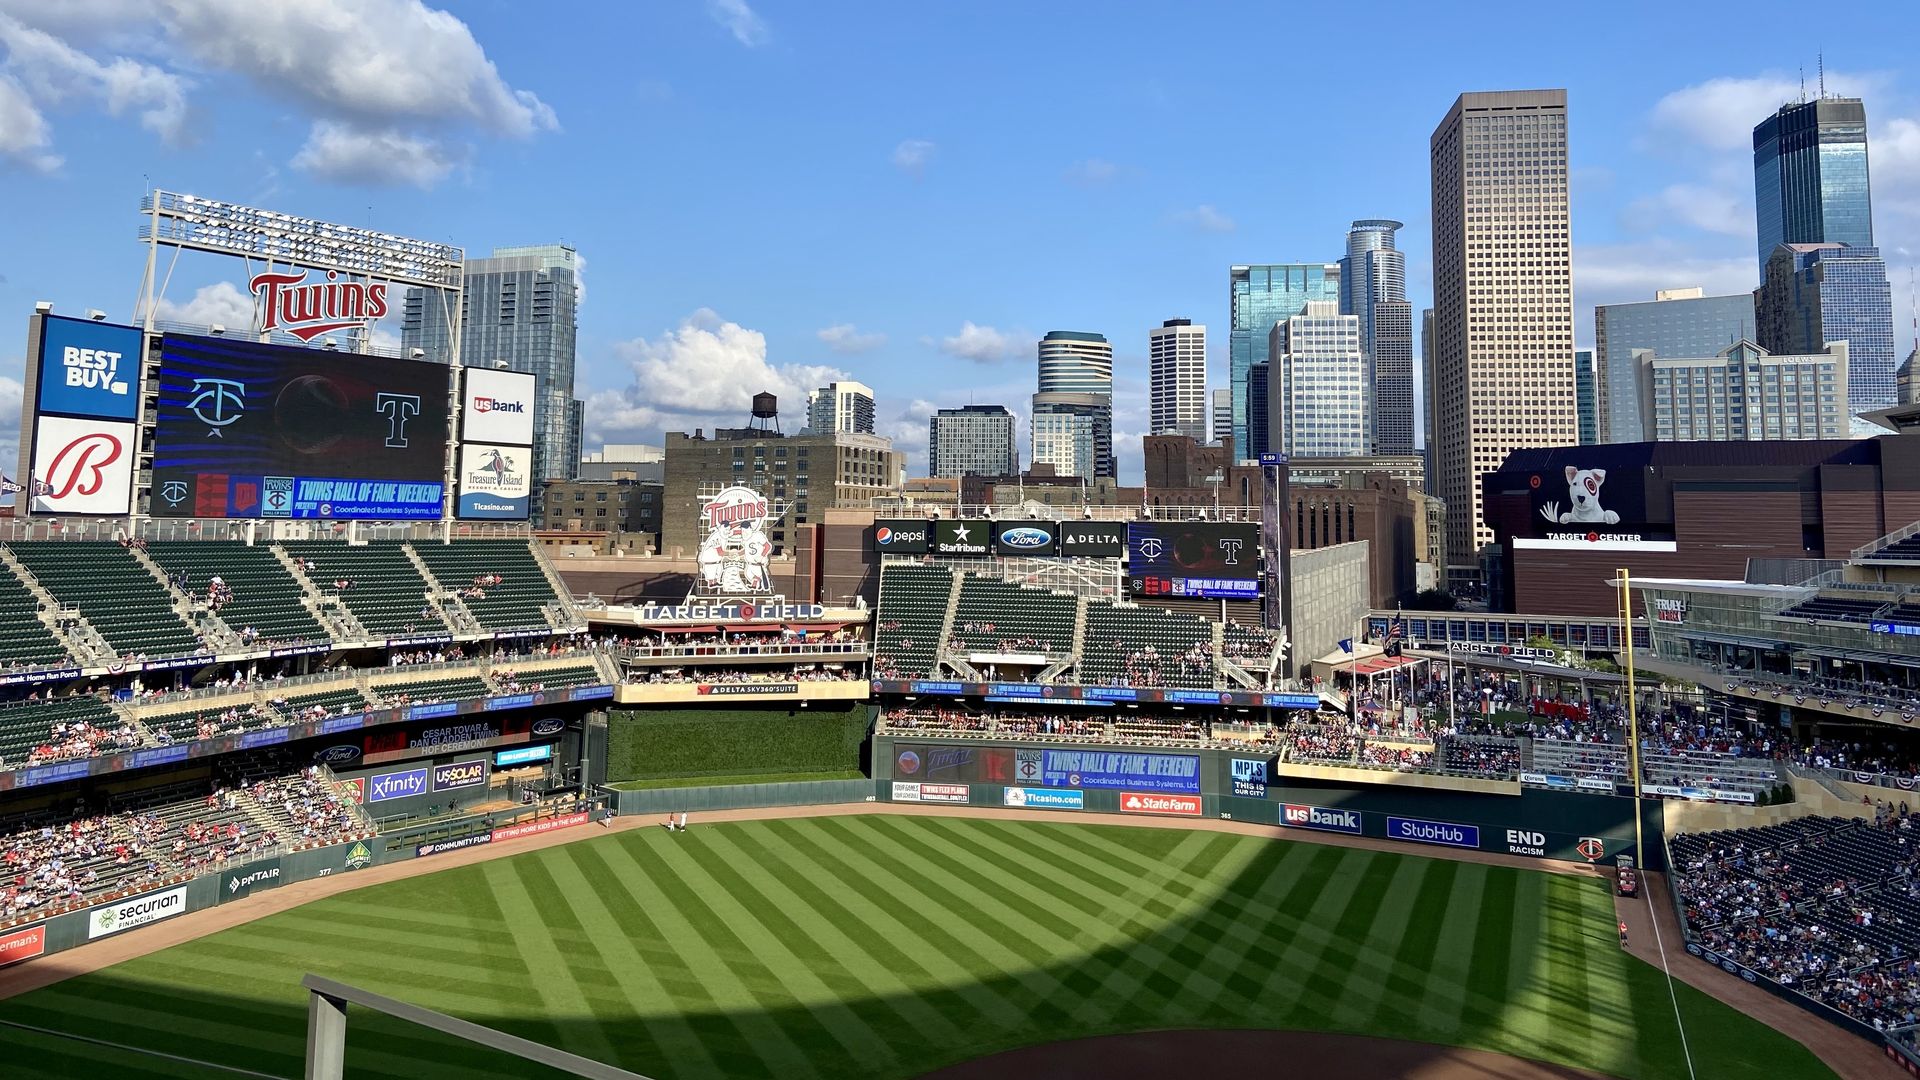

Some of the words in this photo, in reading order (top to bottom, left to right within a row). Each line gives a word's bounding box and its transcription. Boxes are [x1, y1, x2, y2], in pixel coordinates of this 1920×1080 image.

[249, 270, 388, 332] Twins
[64, 346, 121, 371] BEST
[66, 367, 116, 390] BUY
[468, 472, 497, 485] Treasure
[502, 473, 523, 486] Island
[298, 481, 334, 501] TWINS
[332, 482, 358, 501] HALL
[358, 483, 373, 502] OF
[371, 483, 398, 502] FAME
[397, 484, 441, 503] WEEKEND
[334, 506, 376, 514] Coordinated
[377, 506, 403, 514] Business
[704, 499, 767, 529] Twins
[894, 530, 925, 543] pepsi
[1010, 531, 1040, 545] Ford
[1079, 534, 1119, 544] DELTA
[1546, 532, 1587, 541] TARGET
[1599, 533, 1641, 542] CENTER
[645, 606, 738, 620] TARGET
[759, 604, 825, 619] FIELD
[1513, 647, 1555, 658] FIELD
[170, 660, 186, 668] Home
[197, 657, 213, 665] Porch
[26, 674, 45, 682] Home
[60, 670, 78, 679] Porch
[422, 728, 451, 739] CESAR
[452, 724, 482, 736] TOVAR
[482, 723, 490, 732] &
[410, 739, 430, 749] DAN
[431, 733, 473, 746] GLADDEN
[473, 729, 500, 741] TWINS
[326, 747, 352, 761] Ford
[421, 745, 441, 755] HOF
[441, 739, 489, 752] CEREMONY
[1048, 751, 1082, 772] TWINS
[1080, 753, 1105, 773] HALL
[1106, 753, 1121, 774] OF
[1119, 754, 1149, 775] FAME
[1147, 756, 1197, 778] WEEKEND
[1235, 761, 1263, 776] MPLS
[373, 774, 425, 797] xfinity
[1083, 776, 1126, 786] Coordinated
[1126, 778, 1155, 787] Business
[1234, 781, 1255, 790] THIS
[494, 829, 520, 840] GETTING
[520, 825, 537, 834] MORE
[537, 822, 551, 832] KIDS
[551, 821, 559, 829] IN
[558, 818, 570, 827] THE
[569, 815, 585, 824] GAME
[1401, 822, 1463, 842] StubHub
[434, 837, 473, 852] COMMUNITY
[473, 834, 491, 844] FUND
[1506, 829, 1546, 846] END
[1509, 845, 1544, 856] RACISM
[319, 868, 332, 877] 377
[119, 894, 179, 920] securian
[118, 914, 154, 928] FINANCIAL
